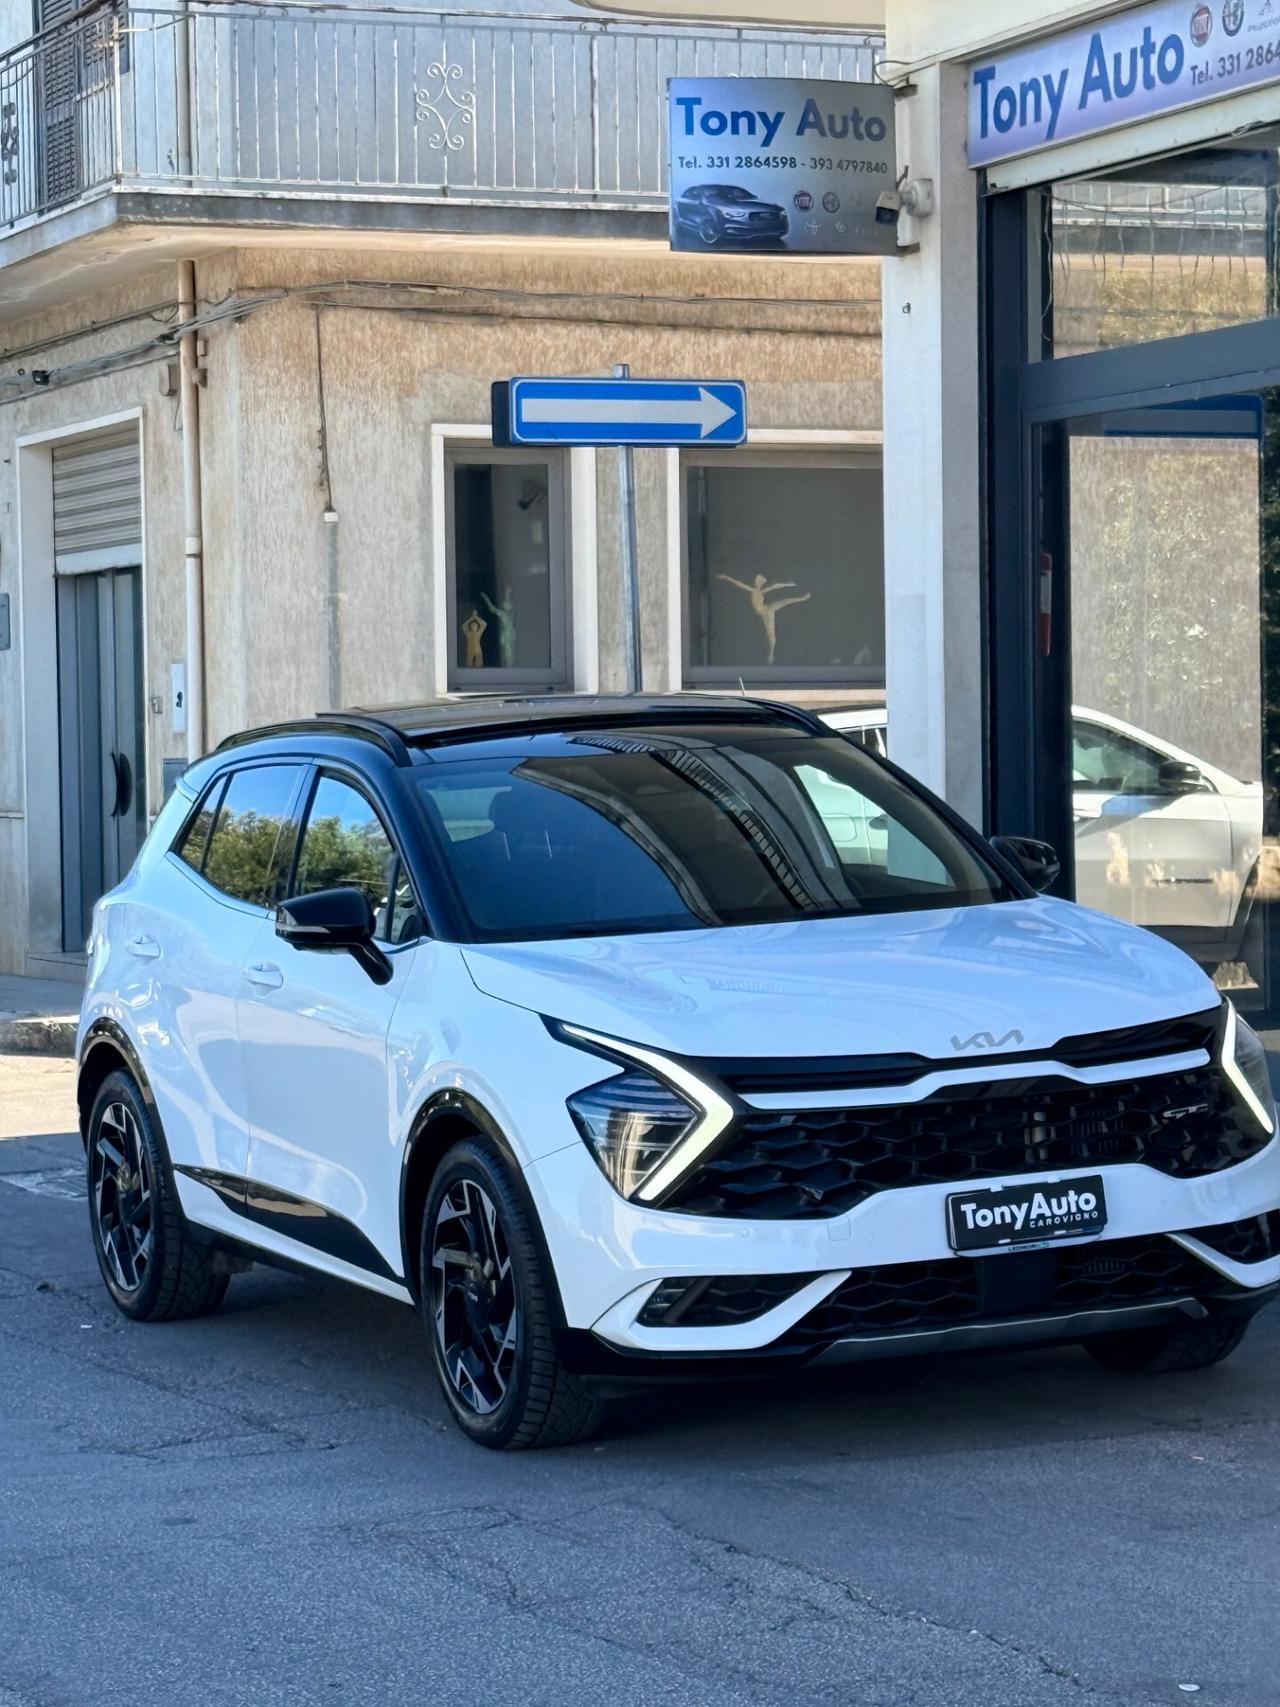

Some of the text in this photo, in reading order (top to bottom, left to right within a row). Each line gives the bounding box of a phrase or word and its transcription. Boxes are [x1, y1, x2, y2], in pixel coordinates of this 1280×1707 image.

[973, 26, 1185, 140] Tony Auto
[1190, 60, 1213, 86] Tel.
[1217, 51, 1241, 79] 331
[676, 97, 887, 148] Tony Auto
[678, 156, 702, 170] Tel.
[706, 156, 730, 169] 331
[735, 156, 797, 169] 2864598
[810, 157, 833, 171] 393
[837, 158, 888, 175] 4797840
[1029, 1211, 1099, 1229] CAROVIGNO
